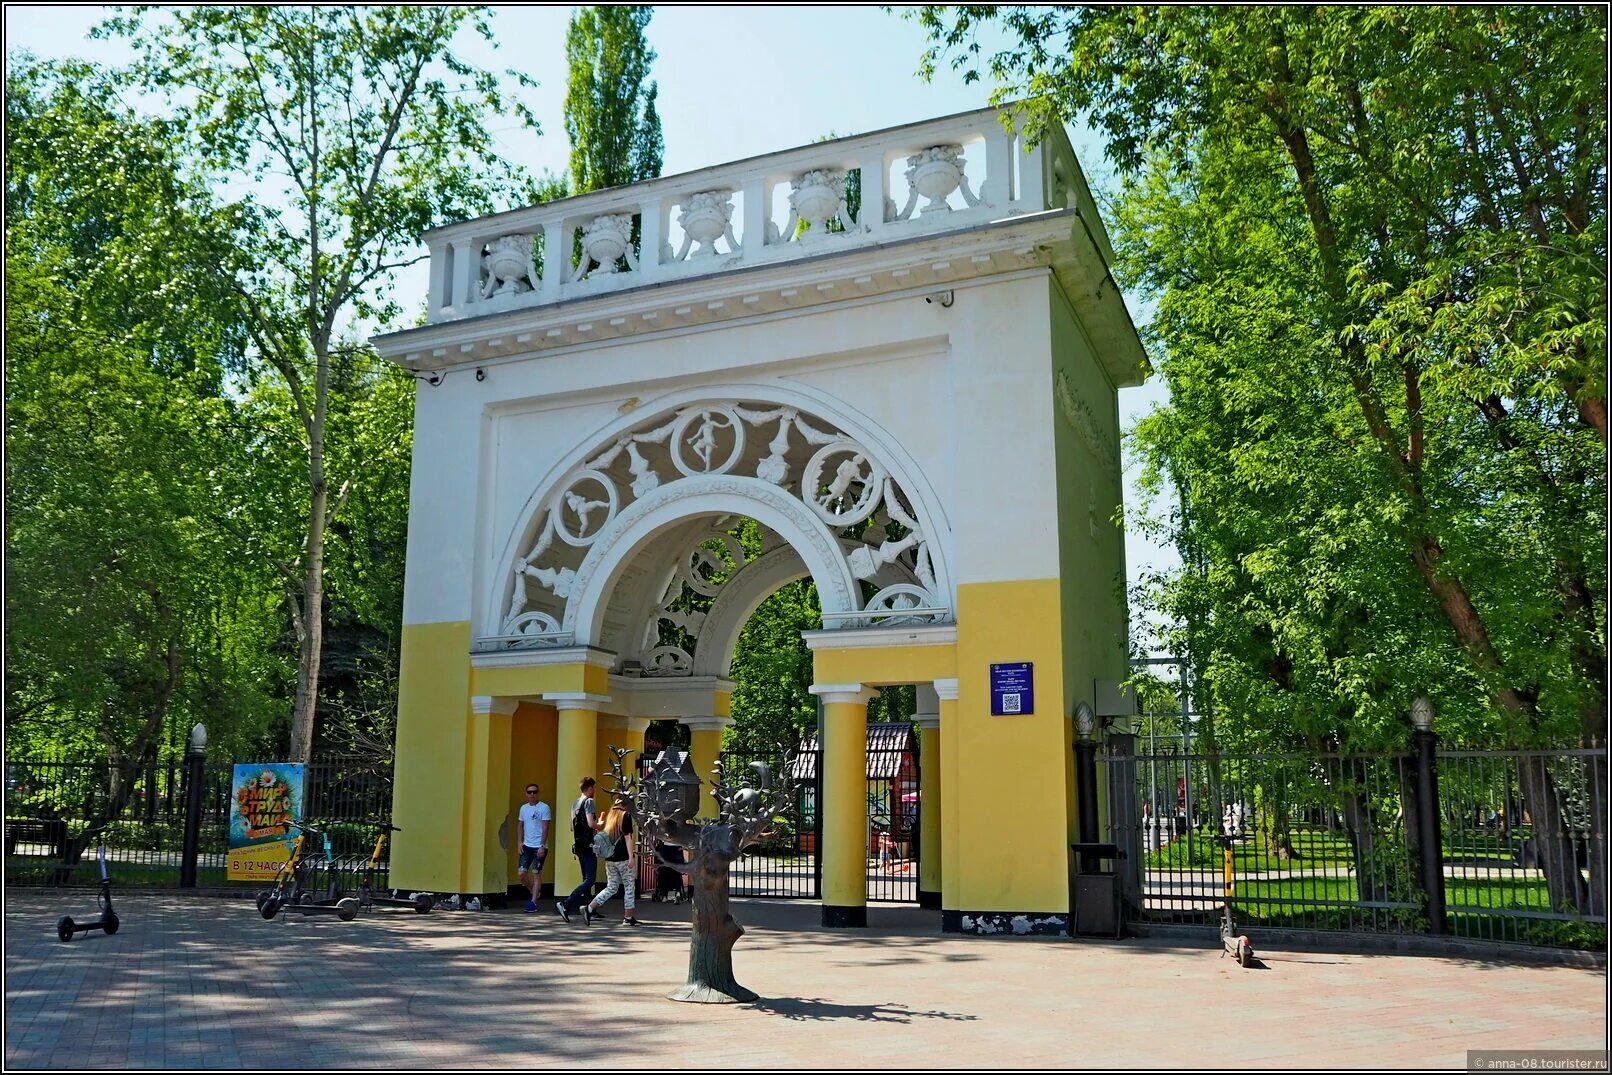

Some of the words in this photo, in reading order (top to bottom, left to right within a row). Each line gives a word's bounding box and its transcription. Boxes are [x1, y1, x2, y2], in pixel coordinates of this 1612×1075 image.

[249, 787, 283, 800] МИР
[248, 800, 283, 813] ТРУД
[233, 860, 240, 870] В
[243, 861, 254, 871] 12
[257, 861, 287, 871] ЧАСО
